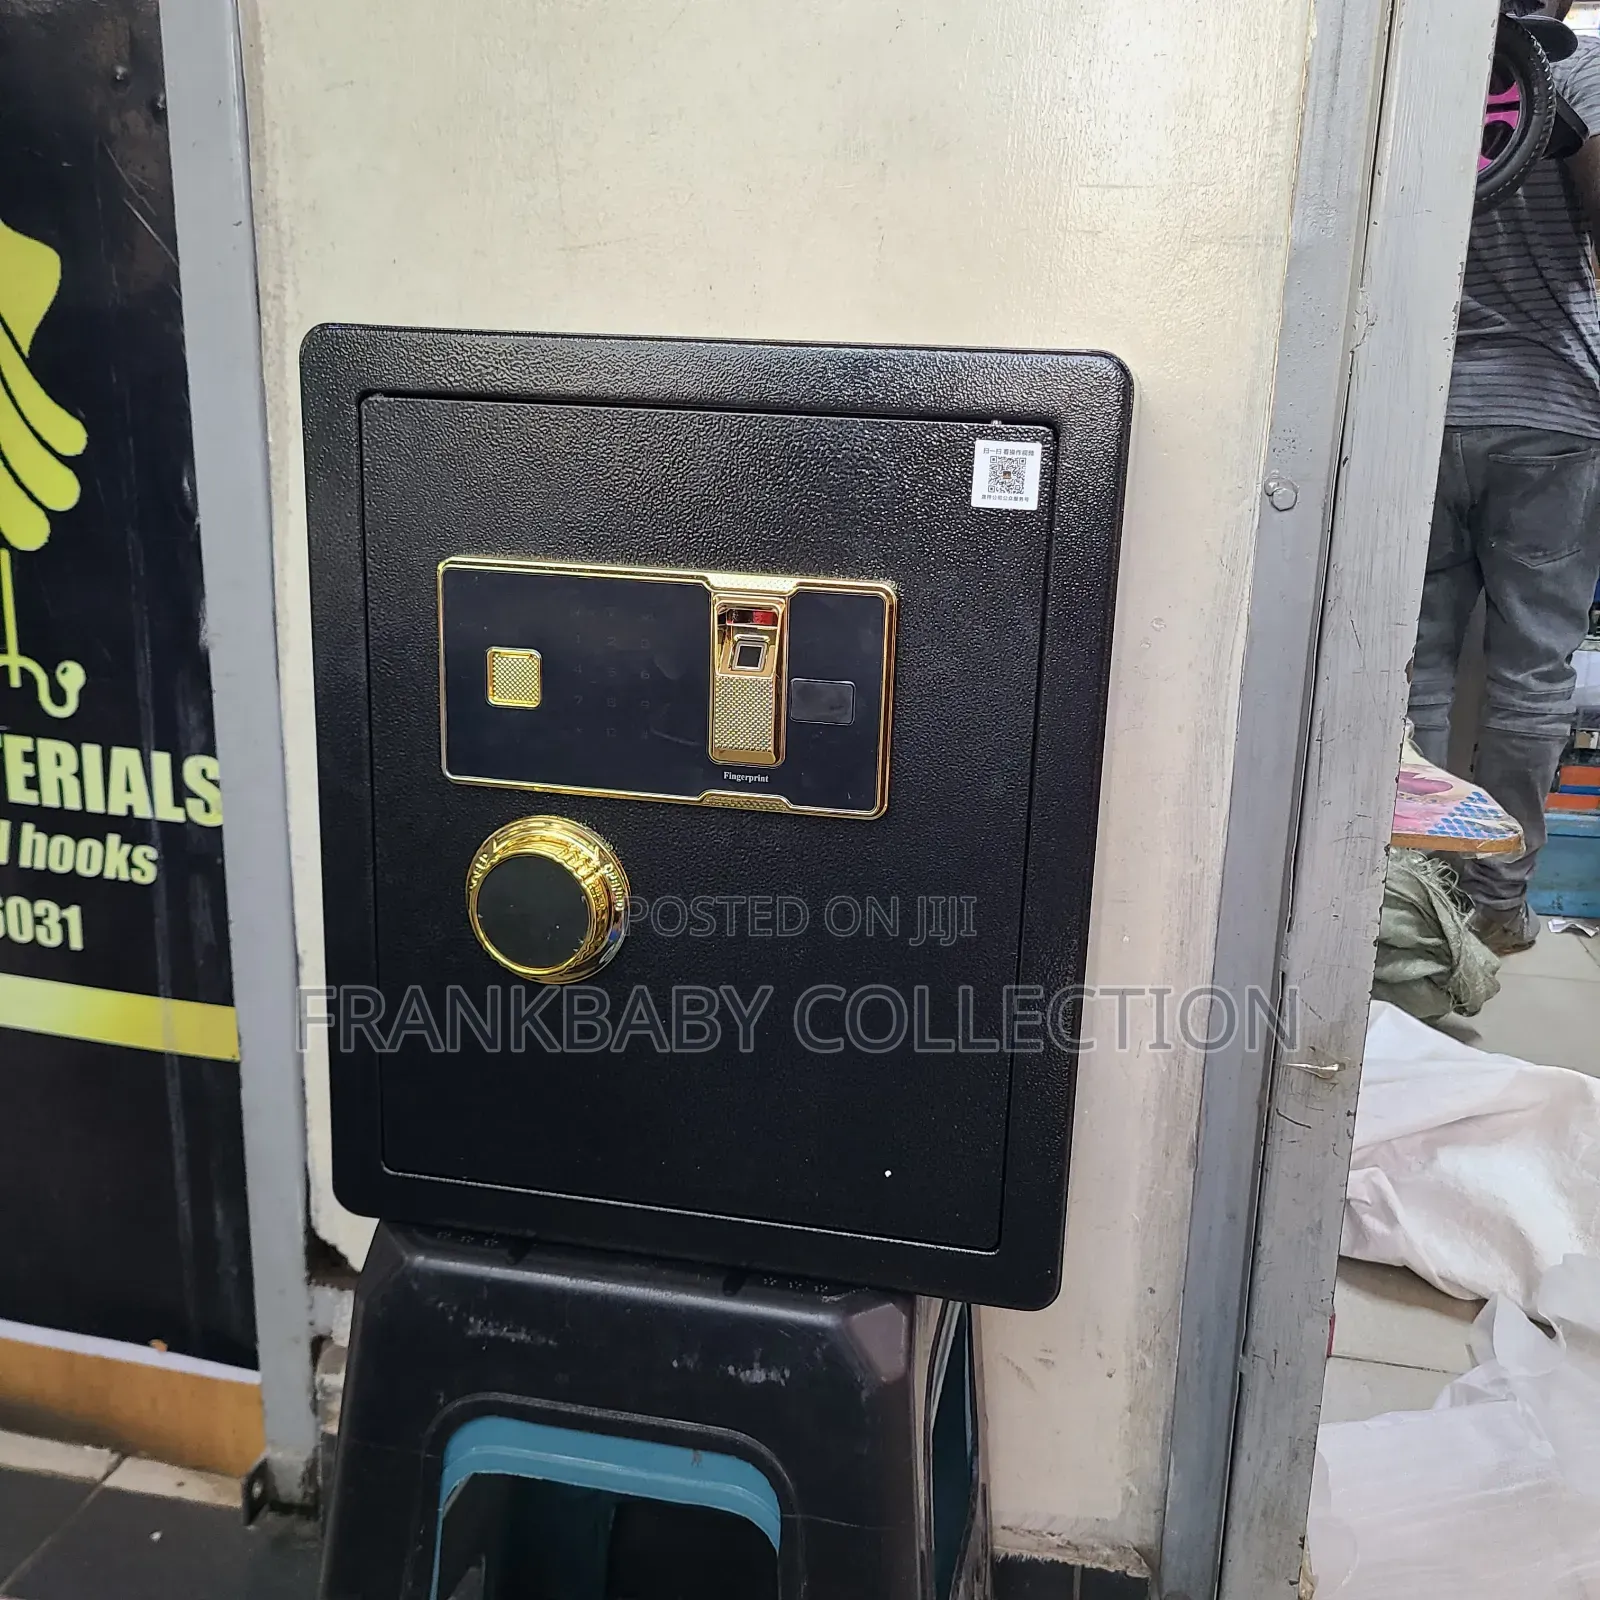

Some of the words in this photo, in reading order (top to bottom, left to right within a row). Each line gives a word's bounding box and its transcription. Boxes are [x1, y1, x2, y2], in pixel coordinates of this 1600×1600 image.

[0, 733, 223, 828] ERIALS
[723, 771, 769, 783] Fingerprint
[19, 821, 159, 885] hooks
